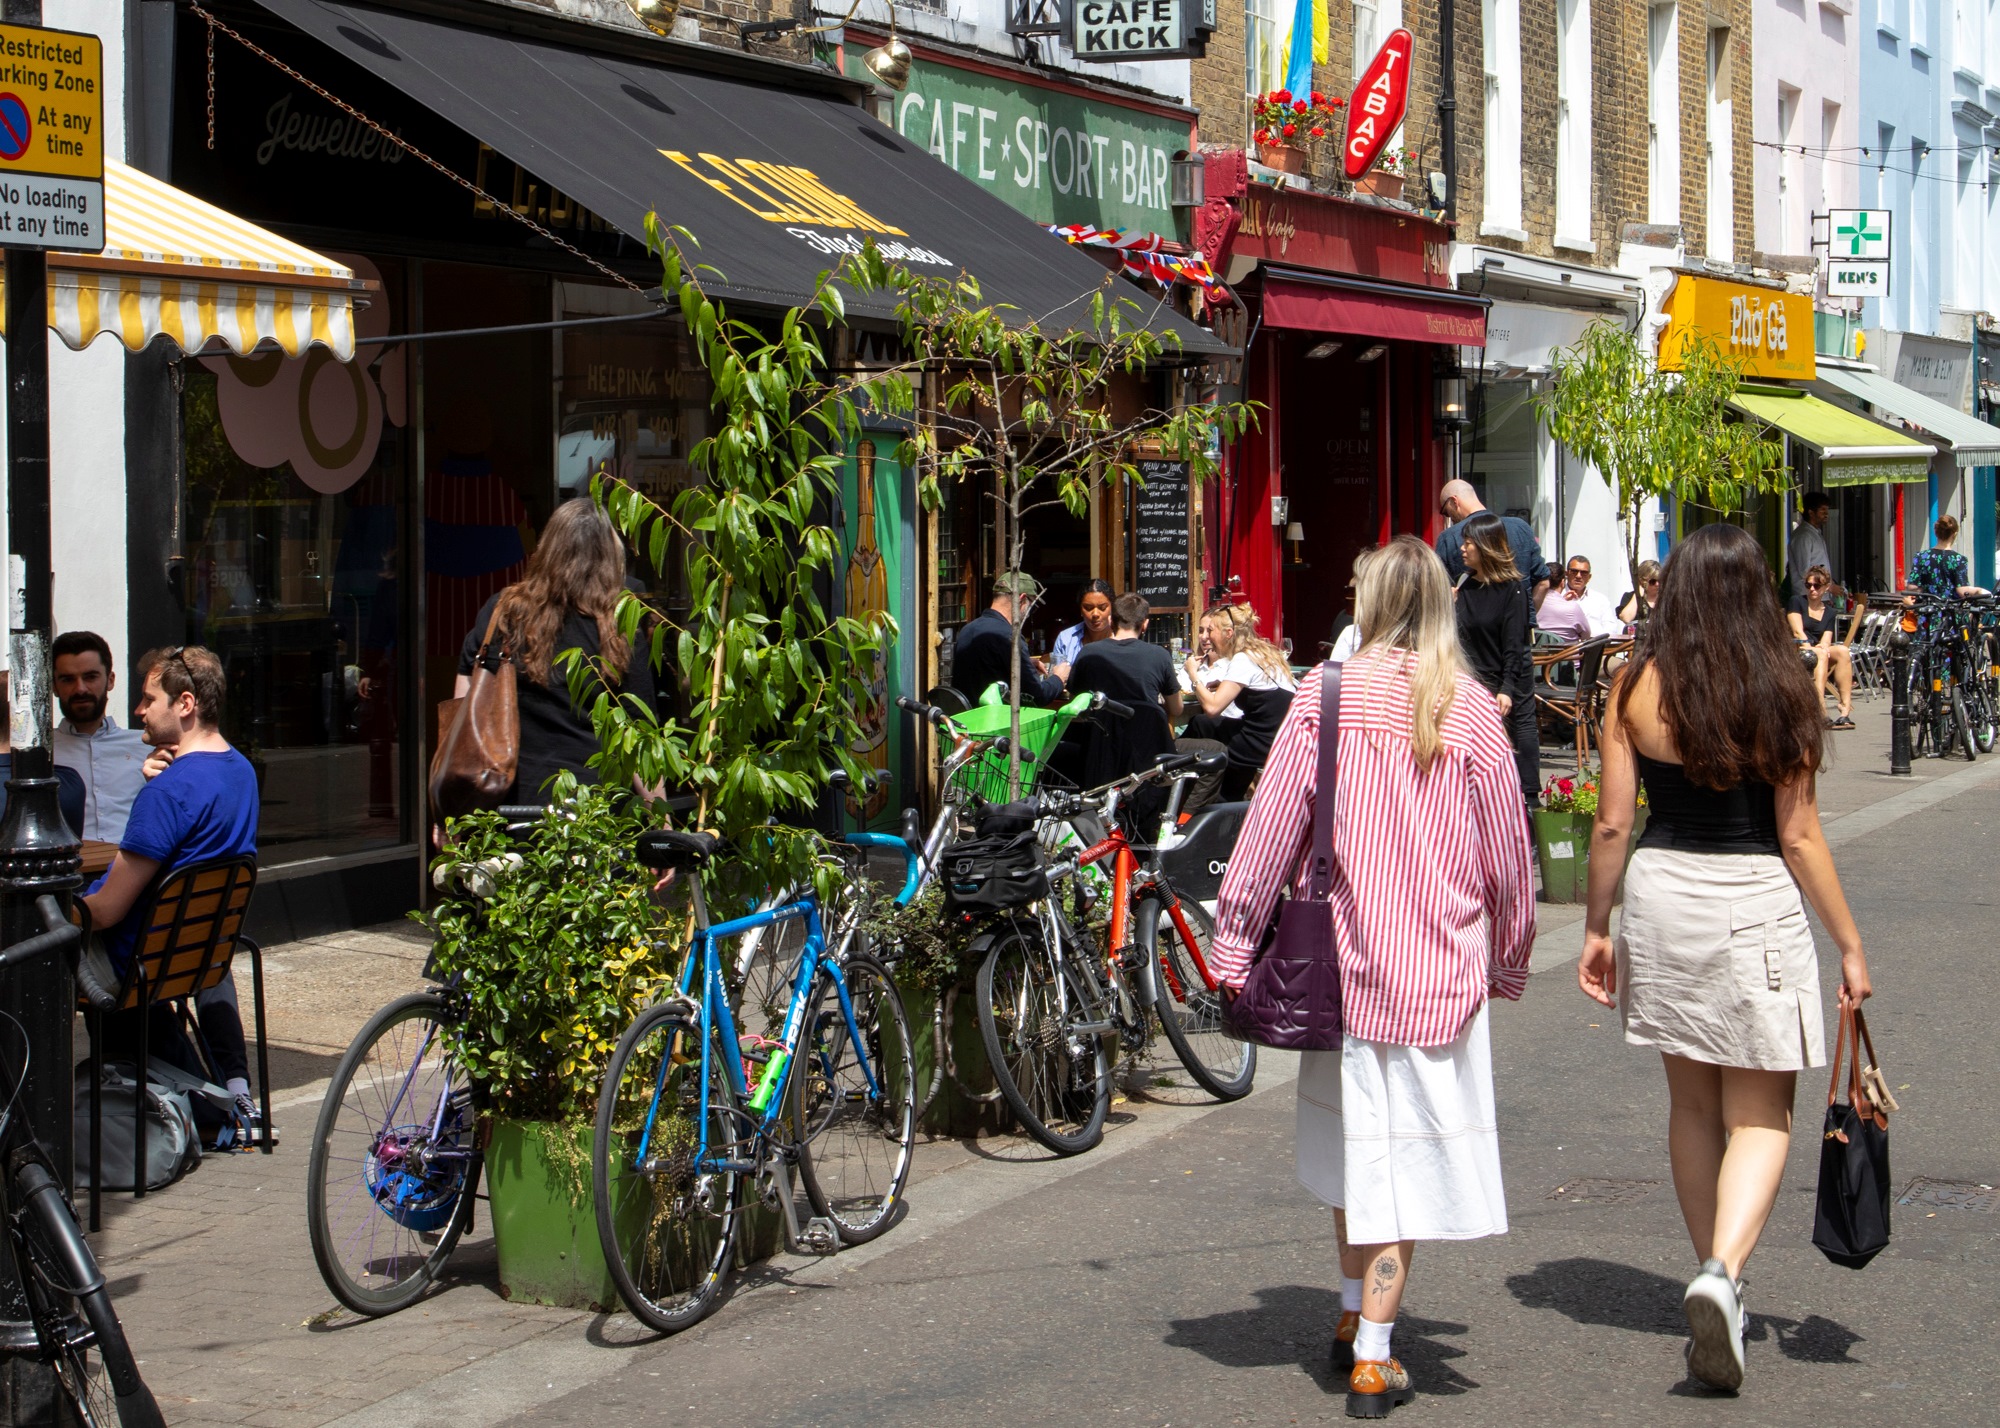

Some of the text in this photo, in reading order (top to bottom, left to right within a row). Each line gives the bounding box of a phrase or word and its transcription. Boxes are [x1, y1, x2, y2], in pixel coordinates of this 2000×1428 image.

[1083, 0, 1171, 25] CAFE
[1086, 26, 1171, 51] KICK
[54, 69, 94, 93] Zone
[1350, 49, 1401, 157] TABAC
[38, 106, 91, 134] At any
[257, 92, 405, 165] Jewellers
[47, 134, 83, 156] time
[900, 92, 1168, 211] CAFE SPORT BAR
[0, 183, 86, 213] No loading
[18, 216, 46, 237] any
[53, 215, 89, 236] time
[1266, 203, 1296, 256] Café
[785, 227, 858, 254] The
[1837, 271, 1878, 284] KEN'S
[1426, 314, 1448, 335] Bistrot
[1449, 317, 1456, 335] &
[1456, 318, 1466, 336] Bar
[1471, 319, 1485, 337] Vin
[1767, 299, 1788, 351] Gà
[587, 363, 657, 398] HELPING
[1910, 355, 1954, 381] MARBY & ELM
[1326, 438, 1369, 455] OPEN
[1142, 462, 1160, 472] MENU
[651, 842, 671, 850] TREK
